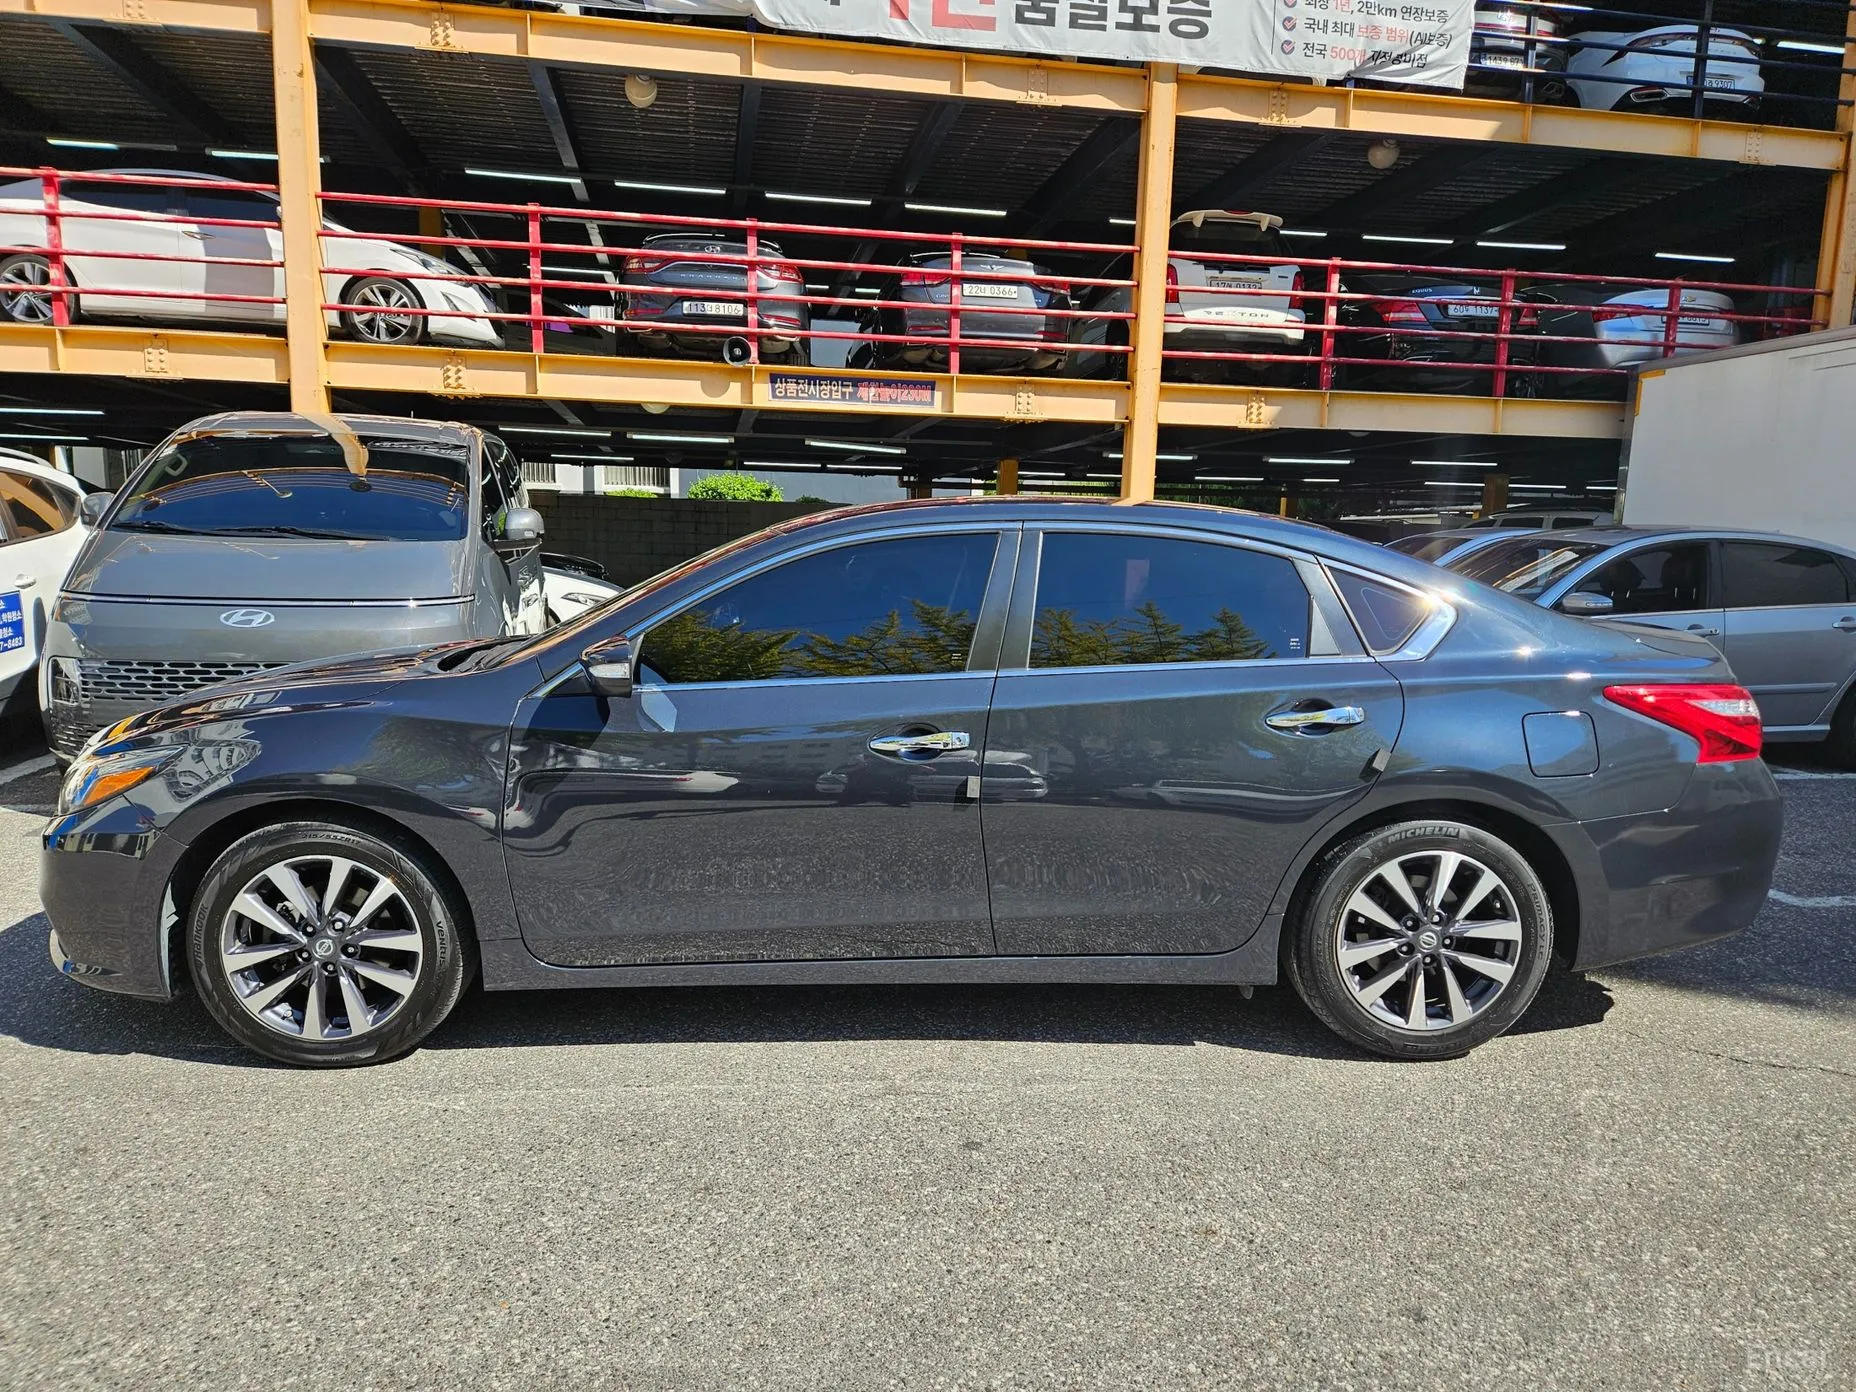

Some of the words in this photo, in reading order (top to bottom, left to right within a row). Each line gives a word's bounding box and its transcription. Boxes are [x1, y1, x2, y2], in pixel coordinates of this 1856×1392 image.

[1357, 1, 1397, 18] 2만km
[1400, 7, 1449, 24] 연장보증
[1304, 17, 1328, 35] 국내
[1332, 20, 1355, 38] 최대
[1302, 41, 1327, 59] 전국
[775, 377, 853, 400] 상품전시장입구
[1388, 826, 1460, 843] MICHELIN
